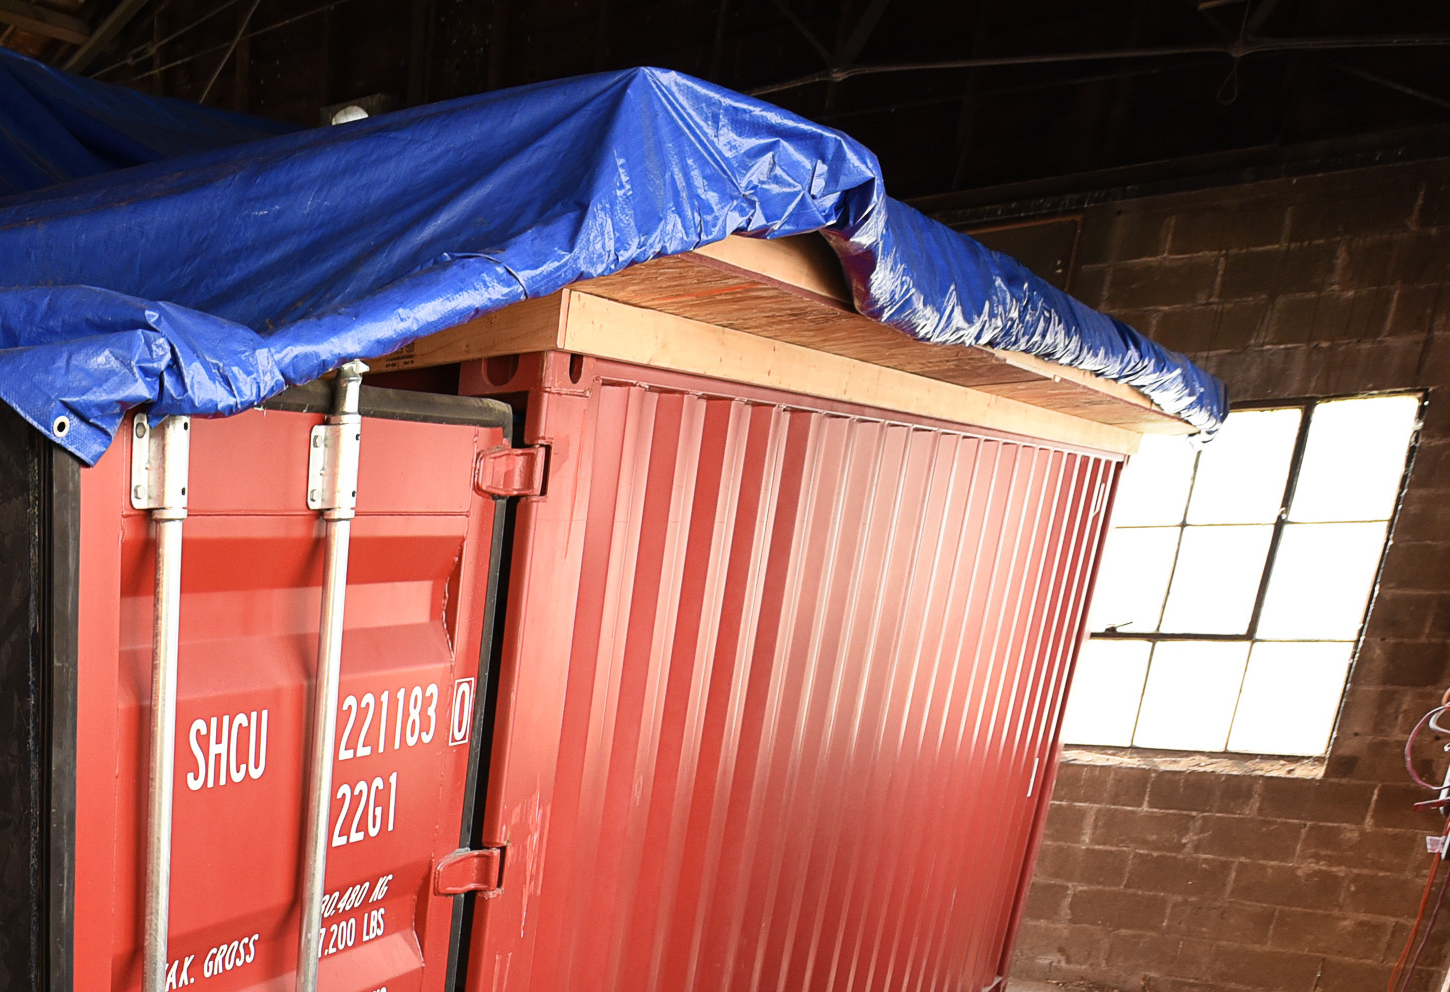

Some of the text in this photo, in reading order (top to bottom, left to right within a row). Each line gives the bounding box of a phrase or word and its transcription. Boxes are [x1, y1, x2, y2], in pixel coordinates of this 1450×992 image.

[186, 709, 269, 791] SHCU
[338, 683, 439, 761] 221183
[331, 772, 398, 847] 22G1
[165, 955, 195, 992] AX.
[203, 933, 260, 978] GROSS
[369, 874, 394, 904] KG
[362, 907, 386, 942] LBS
